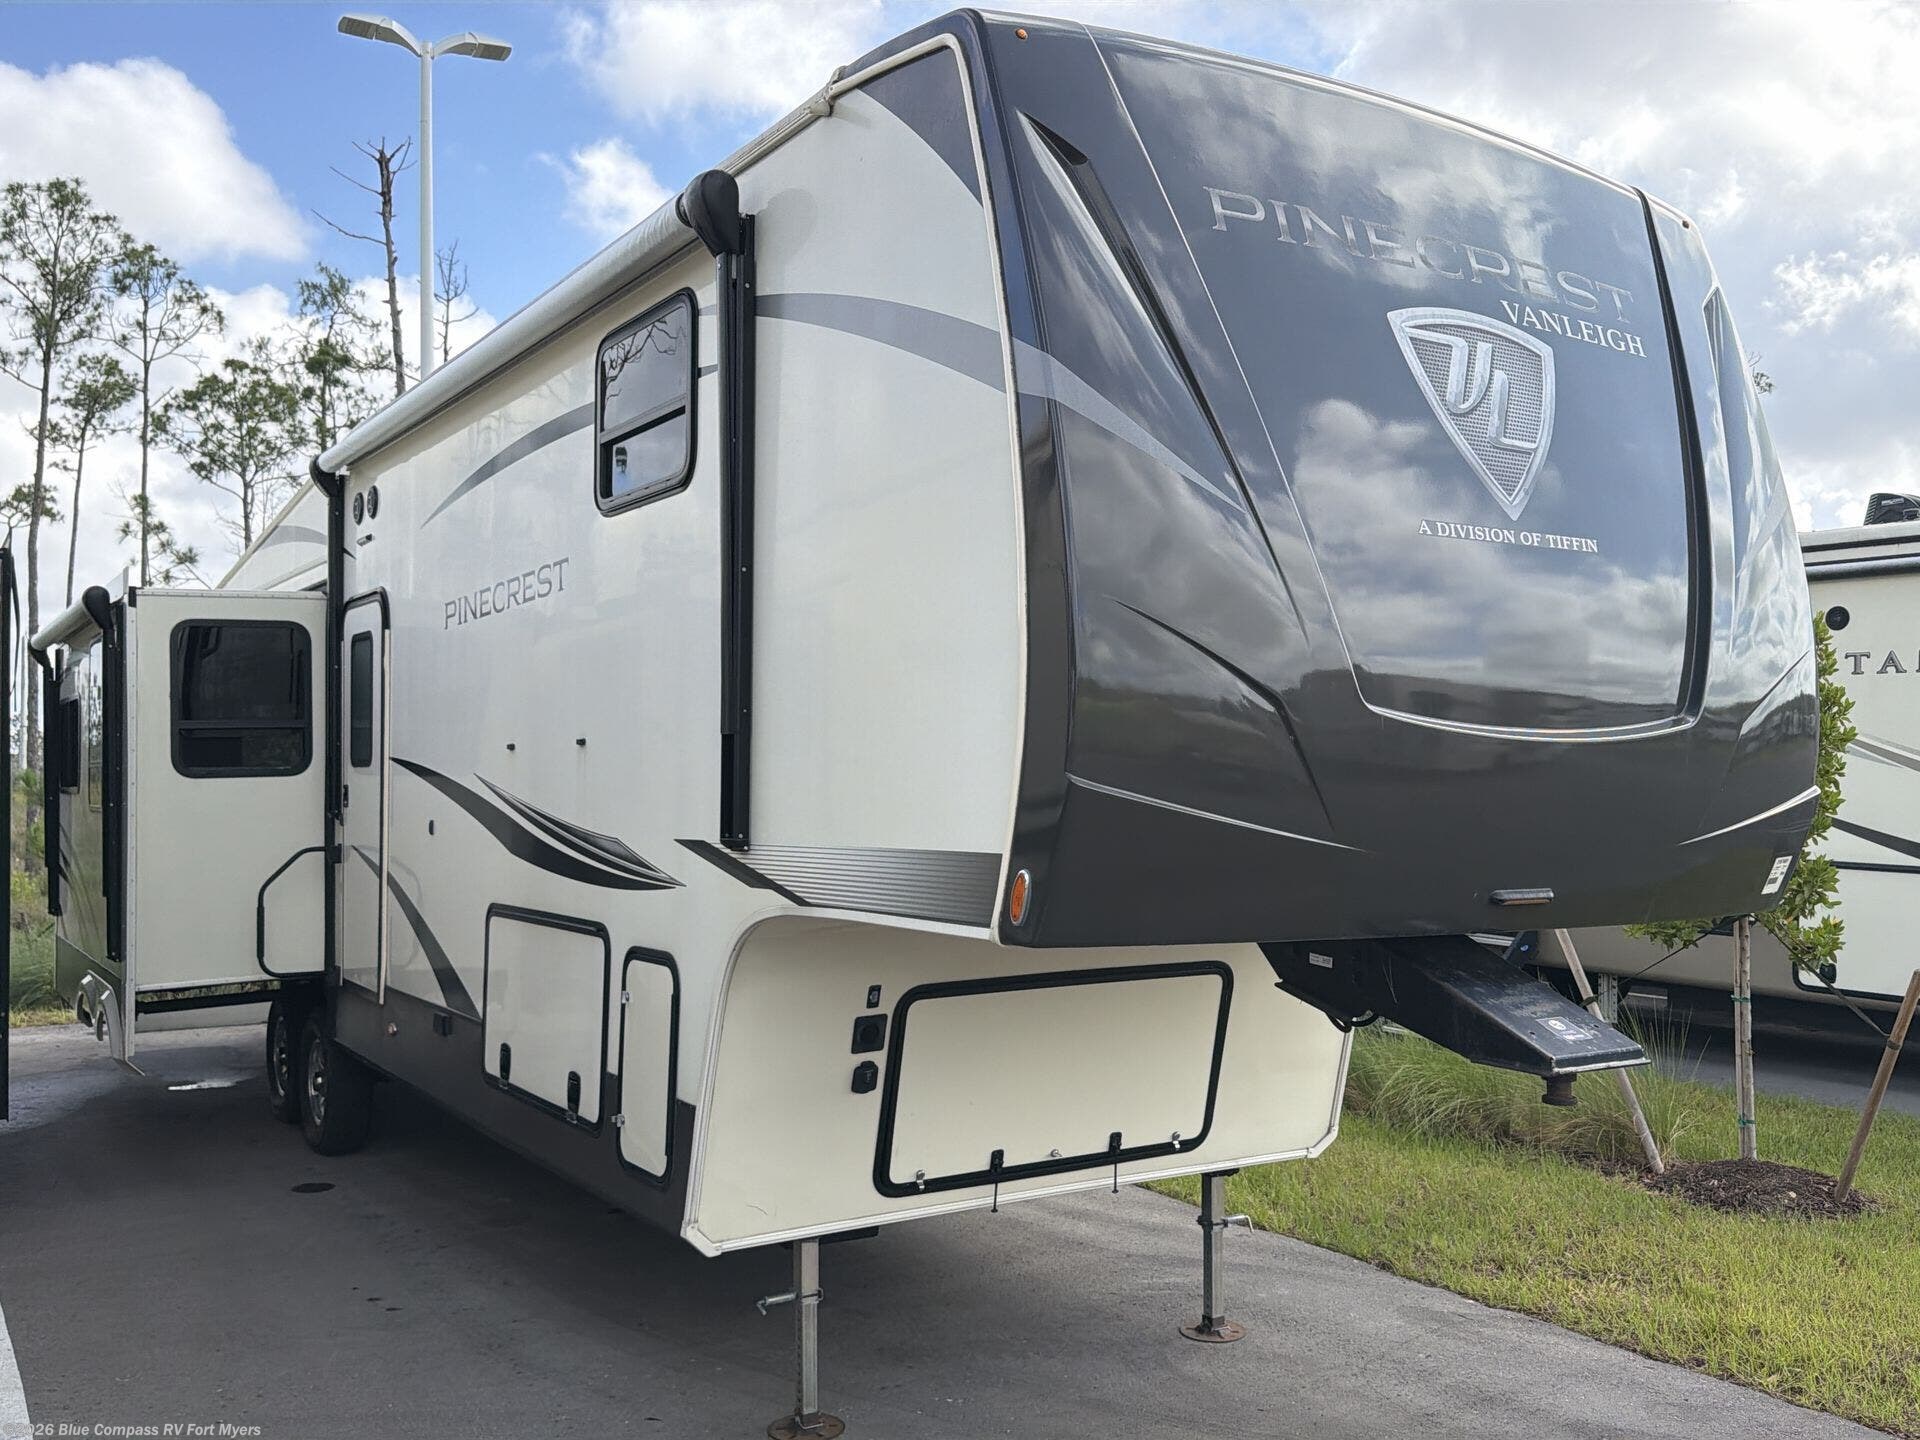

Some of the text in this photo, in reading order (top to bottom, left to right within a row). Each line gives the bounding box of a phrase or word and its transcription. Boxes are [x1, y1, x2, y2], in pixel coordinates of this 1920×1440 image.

[1203, 186, 1634, 323] PINECREST
[1500, 300, 1647, 358] VANLEIGH
[1418, 520, 1598, 553] A DIVISION OF TIFFIN
[444, 557, 569, 630] PINECREST
